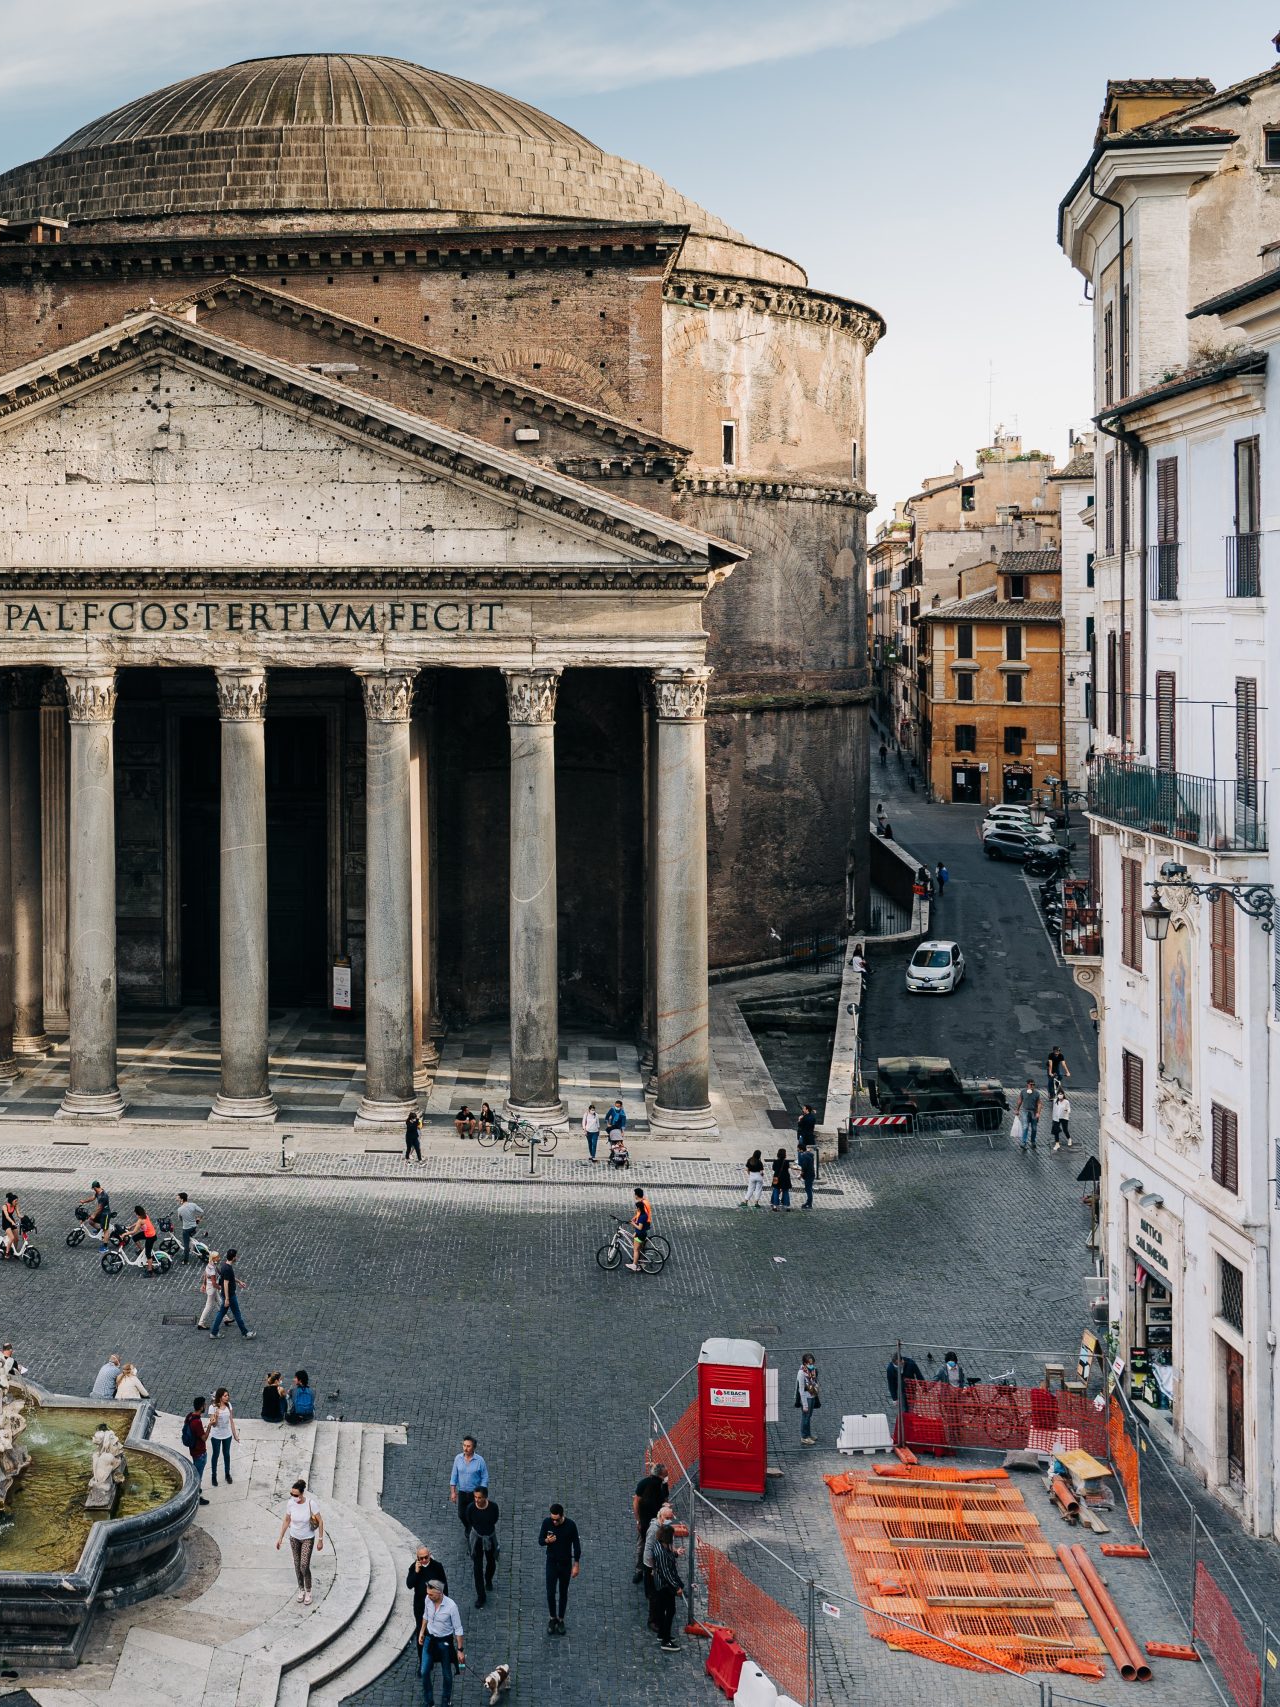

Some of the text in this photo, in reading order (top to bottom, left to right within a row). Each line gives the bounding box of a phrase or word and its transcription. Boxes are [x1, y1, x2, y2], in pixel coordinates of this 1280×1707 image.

[196, 602, 378, 633] TERTIVM
[387, 602, 505, 632] FECIT
[1140, 1218, 1163, 1245] ANTICA
